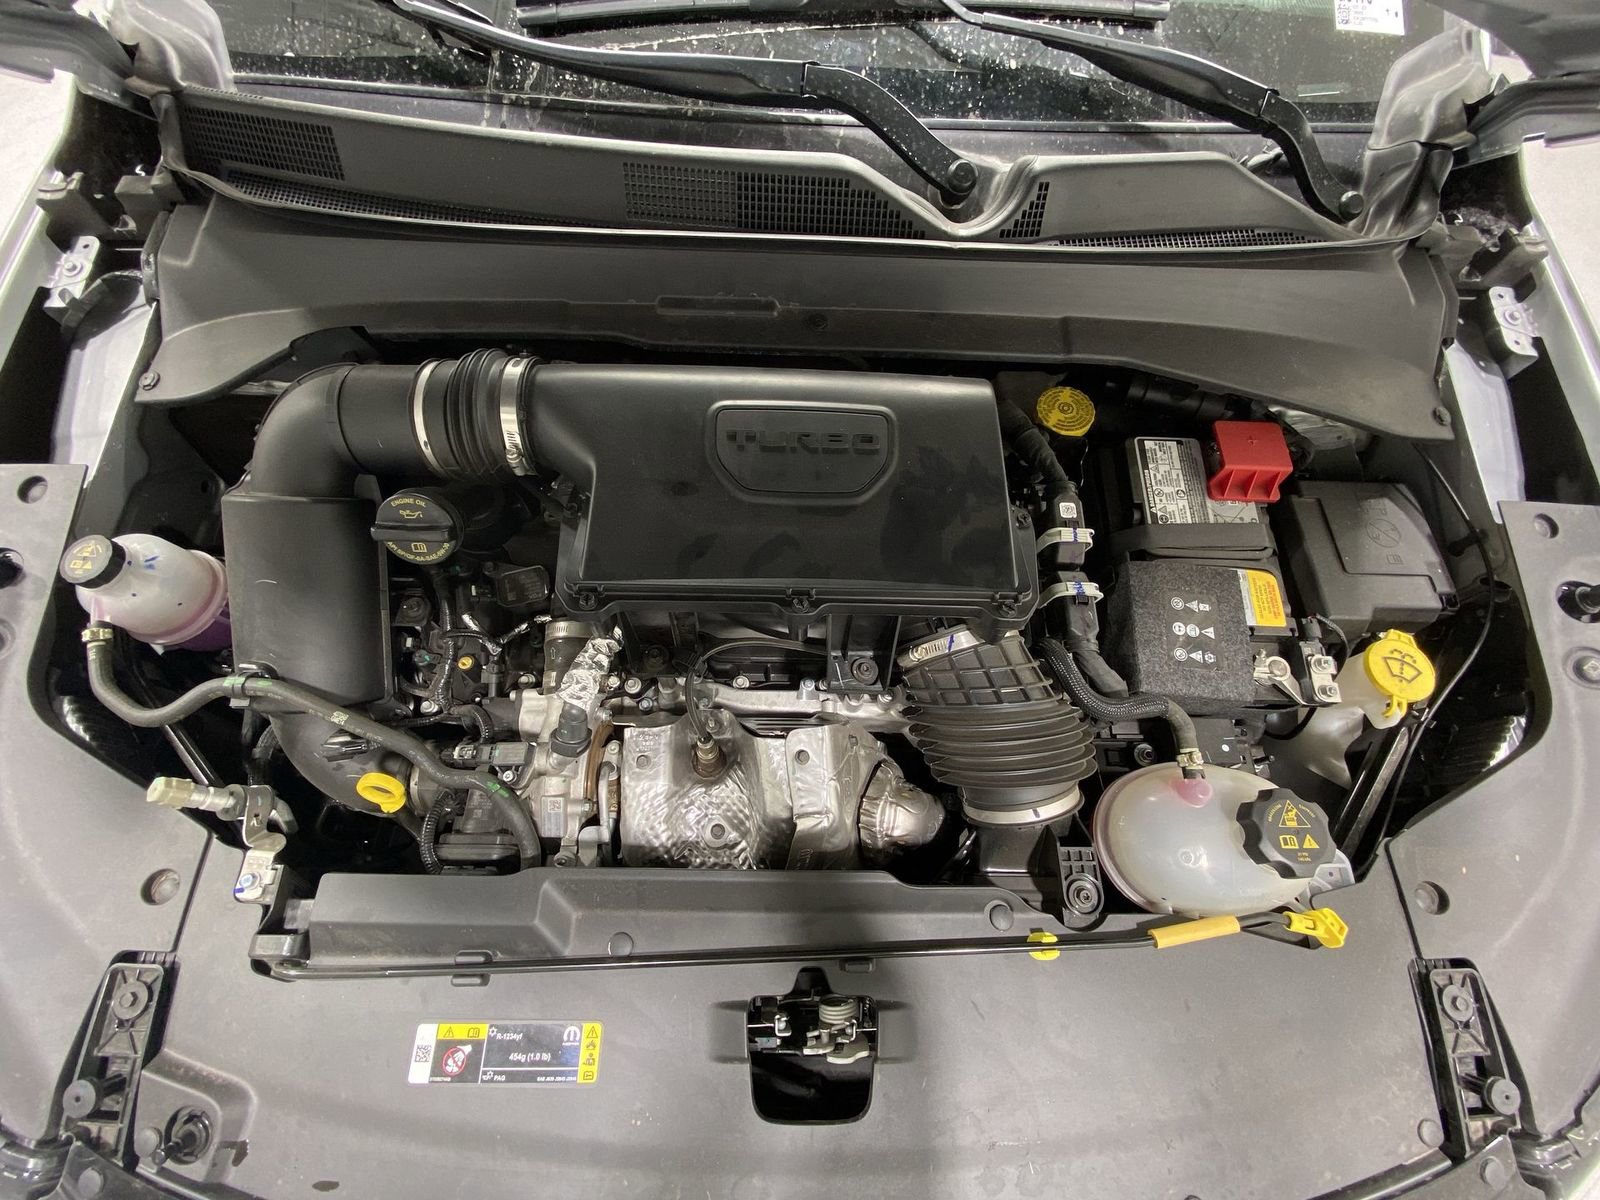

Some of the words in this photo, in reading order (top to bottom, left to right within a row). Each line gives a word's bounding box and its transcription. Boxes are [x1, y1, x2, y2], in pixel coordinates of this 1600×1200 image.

[726, 429, 881, 455] TURBO
[391, 498, 414, 507] ENGINE
[415, 499, 427, 508] OIL
[509, 1052, 526, 1063] 454g
